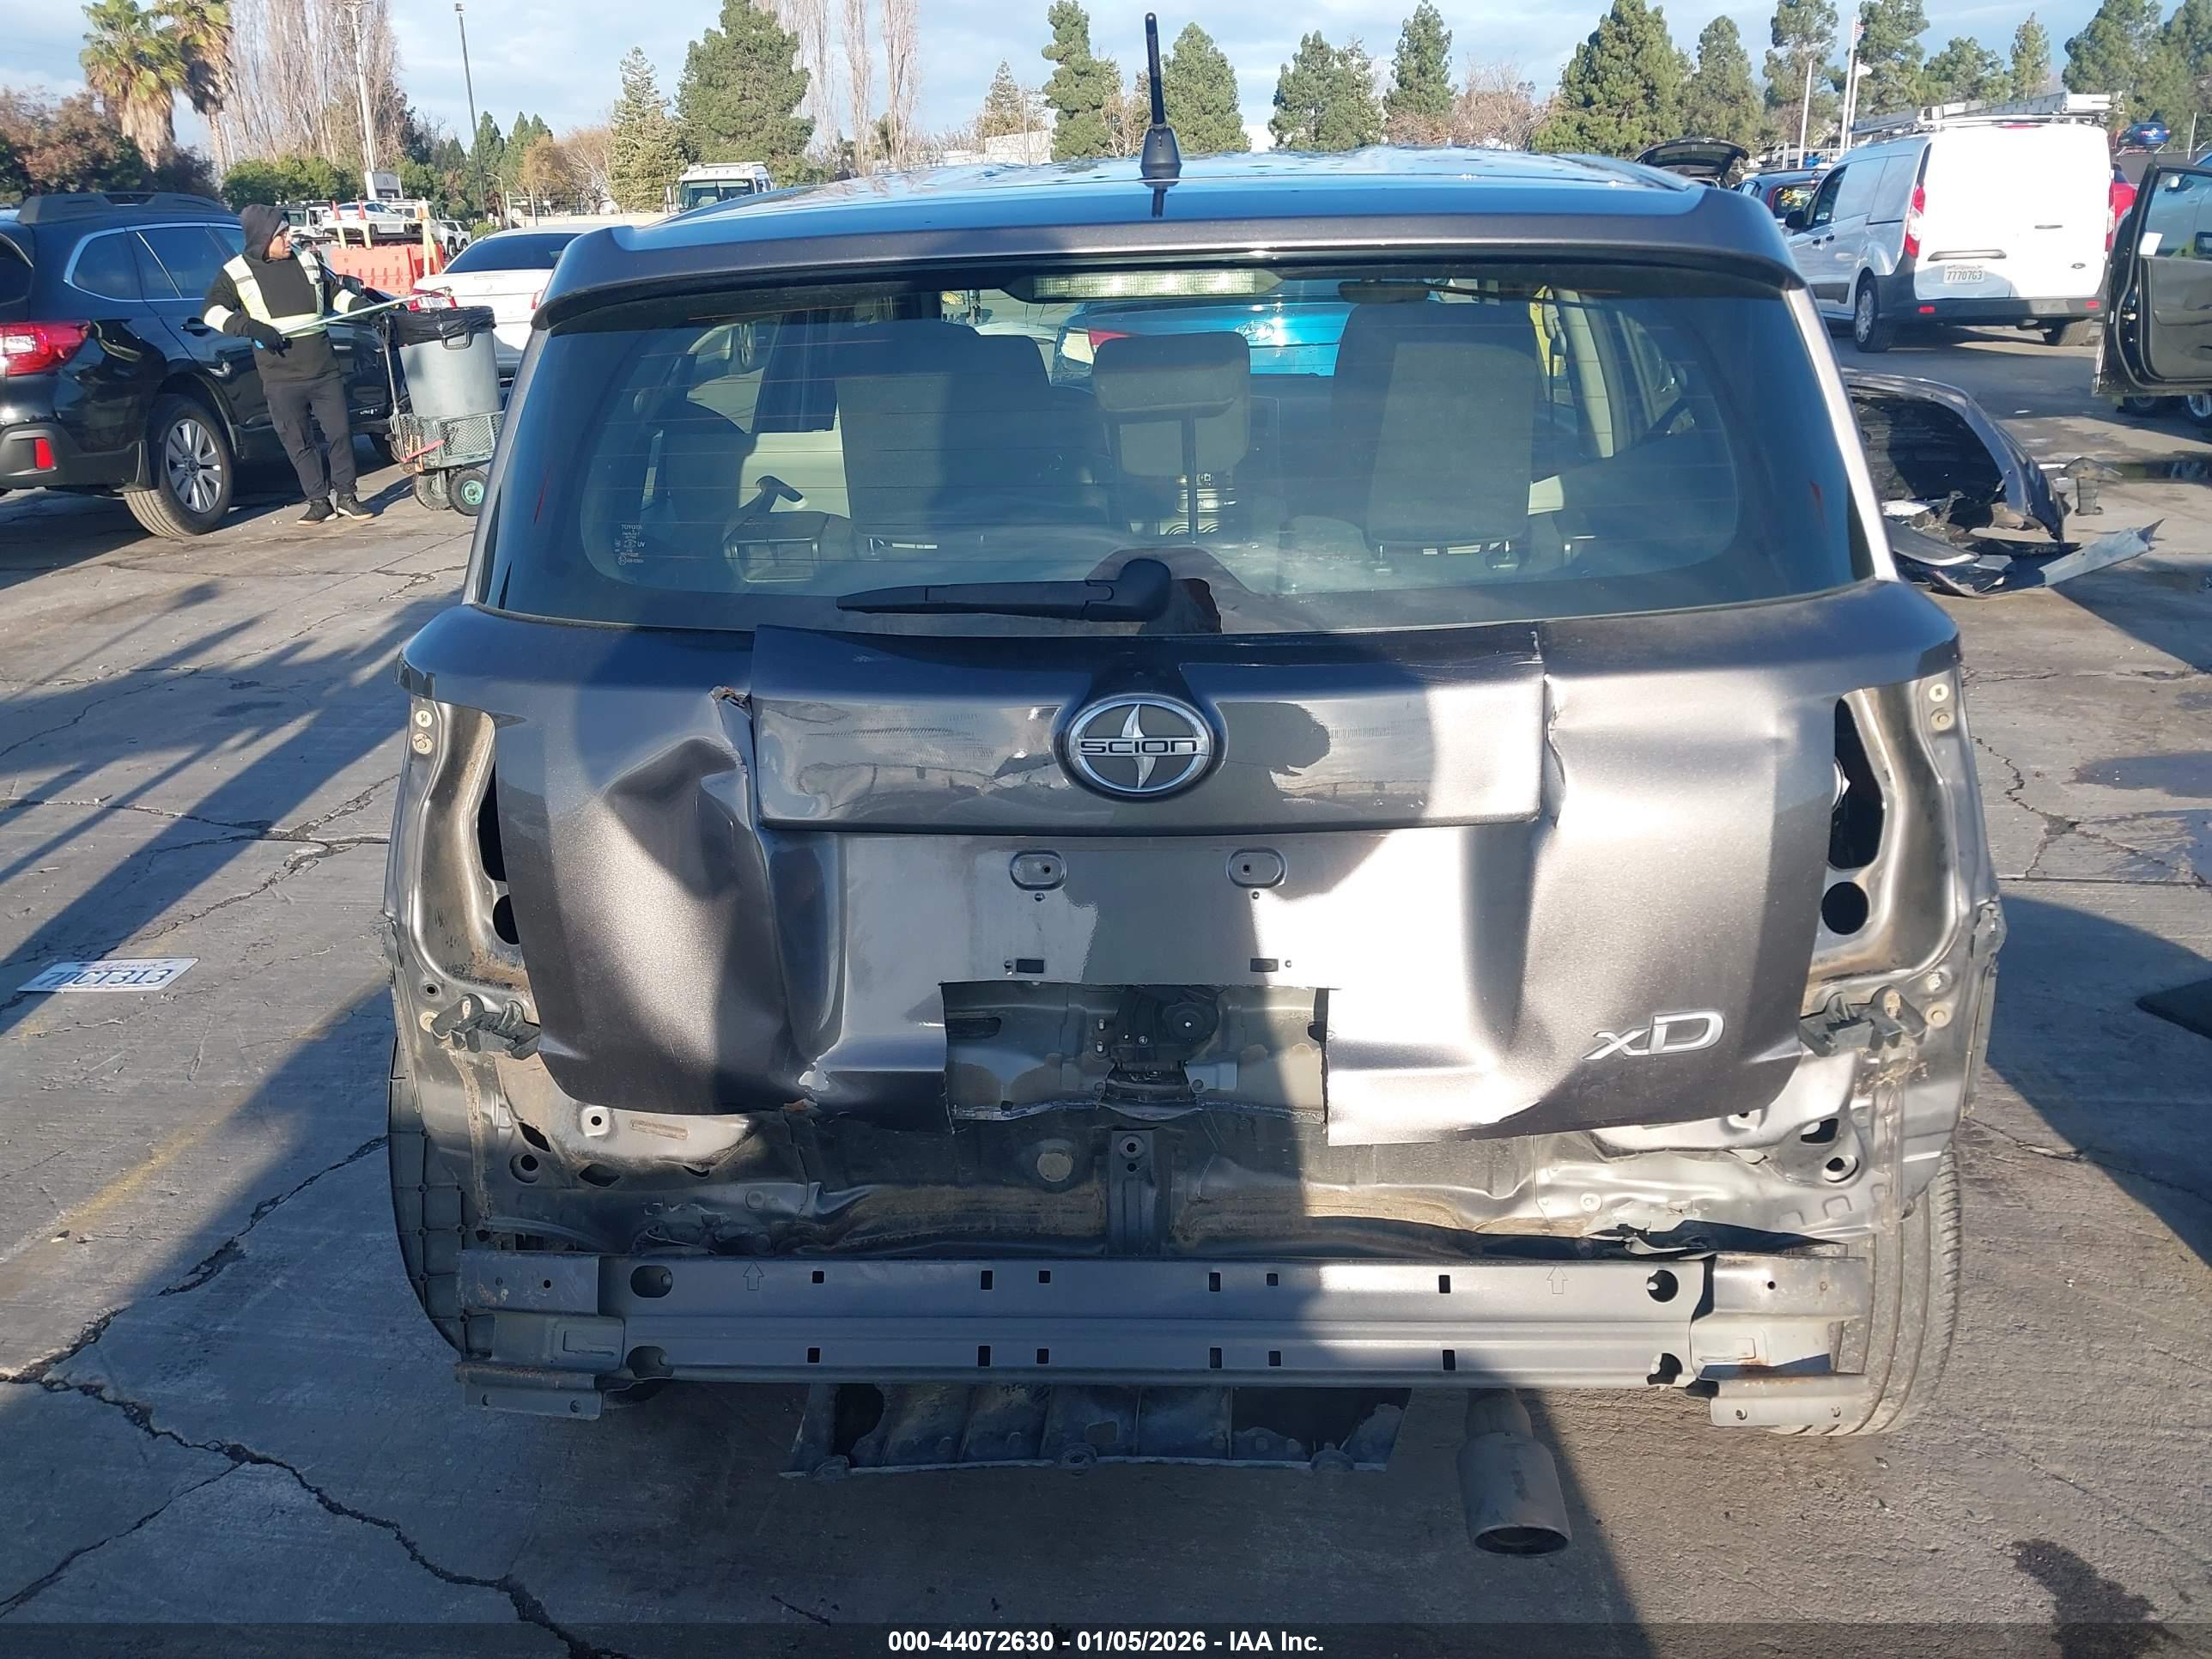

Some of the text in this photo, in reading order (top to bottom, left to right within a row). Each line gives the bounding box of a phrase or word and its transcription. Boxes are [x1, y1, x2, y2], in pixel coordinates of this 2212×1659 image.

[1947, 270, 1983, 281] 77707G3
[36, 968, 173, 987] 7DCT313
[1581, 1010, 1725, 1061] xD
